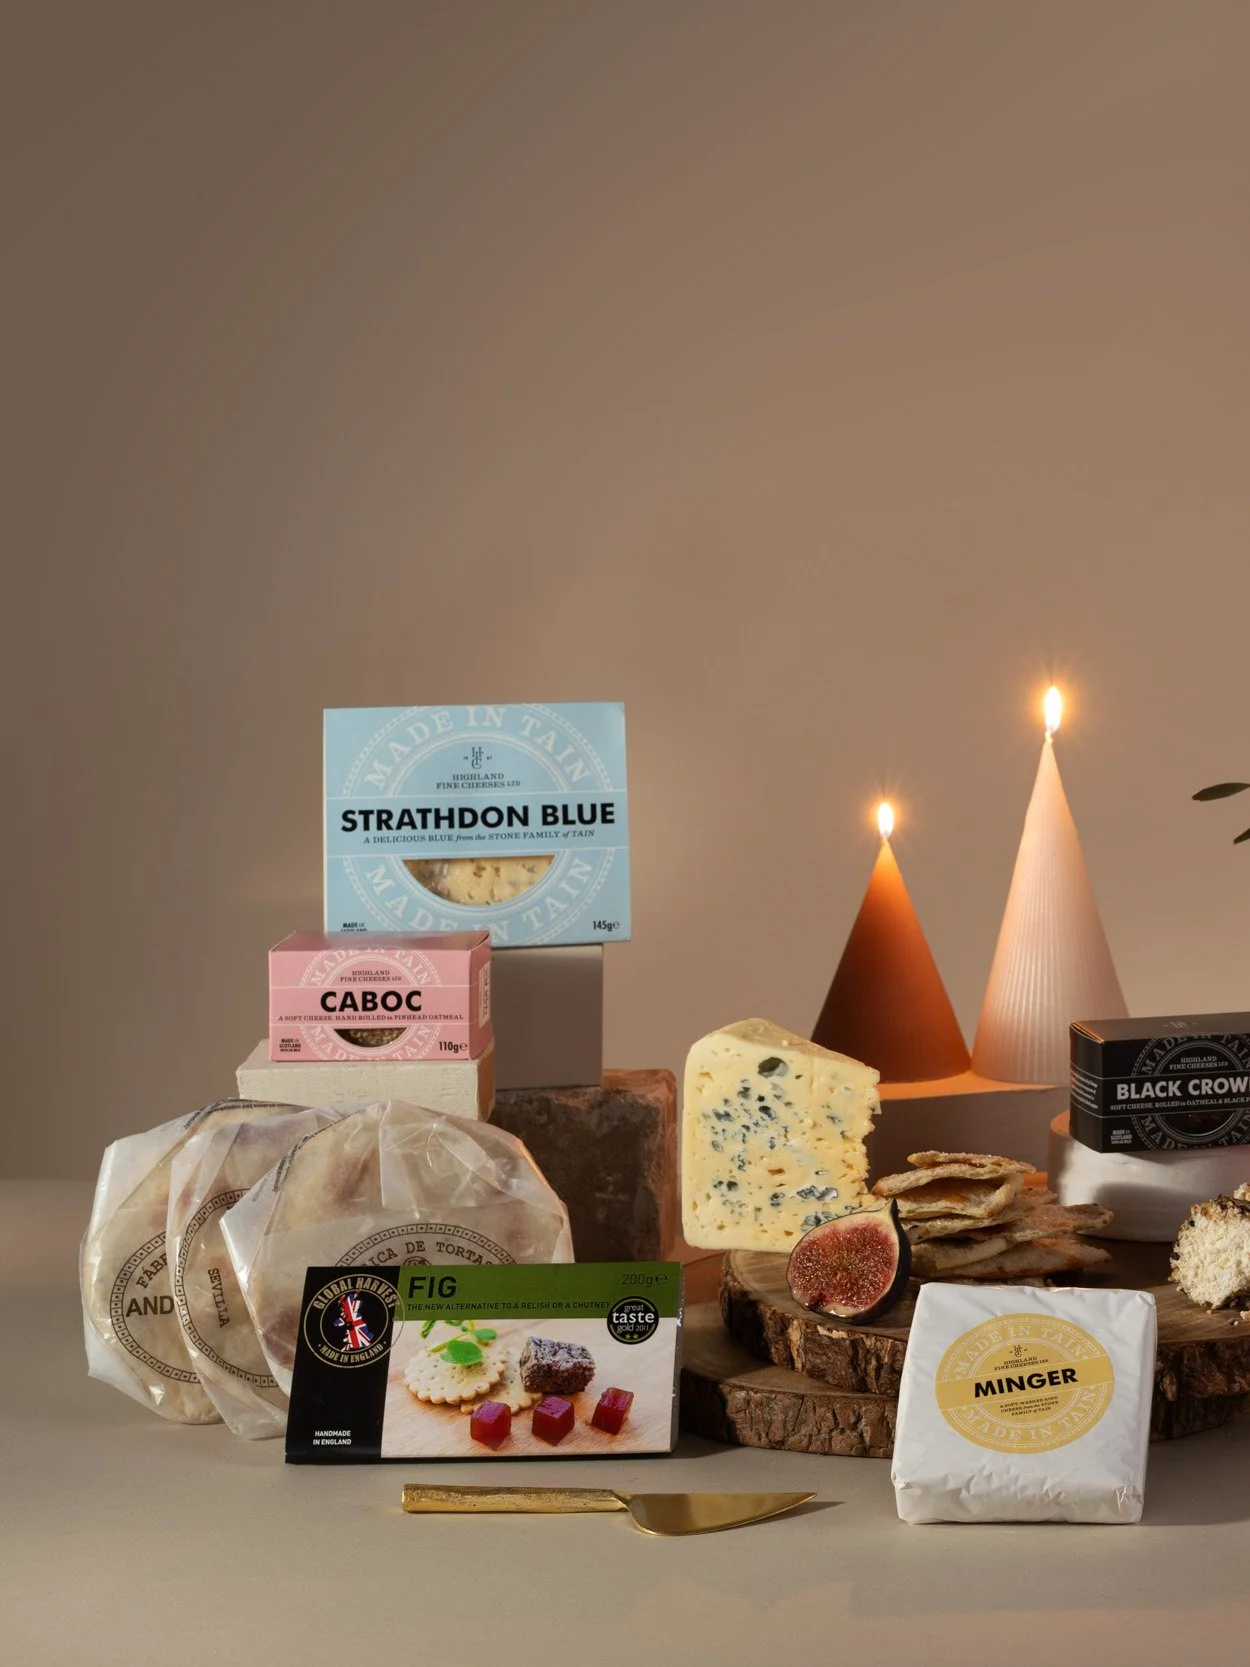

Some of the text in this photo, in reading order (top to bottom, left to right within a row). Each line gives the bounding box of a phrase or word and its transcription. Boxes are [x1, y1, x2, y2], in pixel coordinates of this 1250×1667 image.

[364, 705, 590, 788] MADE IN TAIN
[436, 781, 460, 790] FINE
[461, 781, 505, 790] CHEESES
[453, 773, 504, 781] HIGHLAND
[341, 803, 615, 833] STRATHDON BLUE
[373, 835, 426, 844] DELICIOUS
[428, 834, 454, 842] BLUE
[455, 834, 474, 843] from
[488, 832, 520, 840] STONE
[523, 831, 560, 840] FAMILY
[562, 831, 570, 840] of
[572, 830, 595, 838] TAIN
[366, 864, 459, 931] MADE
[522, 860, 593, 933] TAIN
[311, 948, 431, 986] MADE TAIN
[320, 990, 422, 1013] CABOC
[311, 1024, 431, 1061] MADE TAIN
[1141, 1036, 1187, 1074] MADE
[1181, 1056, 1217, 1064] HIGHLAND
[1116, 1079, 1182, 1100] BLACK
[1110, 1103, 1127, 1111] SOFT
[1141, 1115, 1187, 1150] MADE
[405, 1240, 426, 1254] DE
[207, 1267, 230, 1329] SEVILLA
[312, 1277, 401, 1310] GLOBAL HARVEST
[408, 1276, 457, 1299] FIG
[125, 1295, 175, 1317] AND
[407, 1303, 425, 1311] THE
[424, 1303, 444, 1311] NEW
[445, 1302, 500, 1310] ALTERNATIVE
[501, 1302, 512, 1310] TO
[521, 1301, 550, 1309] RELISH
[572, 1301, 611, 1309] CHUTNEY
[623, 1304, 644, 1313] great
[612, 1311, 655, 1324] taste
[616, 1323, 634, 1334] gold
[319, 1343, 384, 1363] MADE IN ENGLAND
[955, 1325, 1086, 1375] MADE IN TAIN
[1003, 1356, 1038, 1365] HIGHLAND
[974, 1367, 1078, 1398] MINGER
[963, 1391, 1097, 1441] MADE IN TAIN
[321, 1438, 352, 1446] ENGLAND
